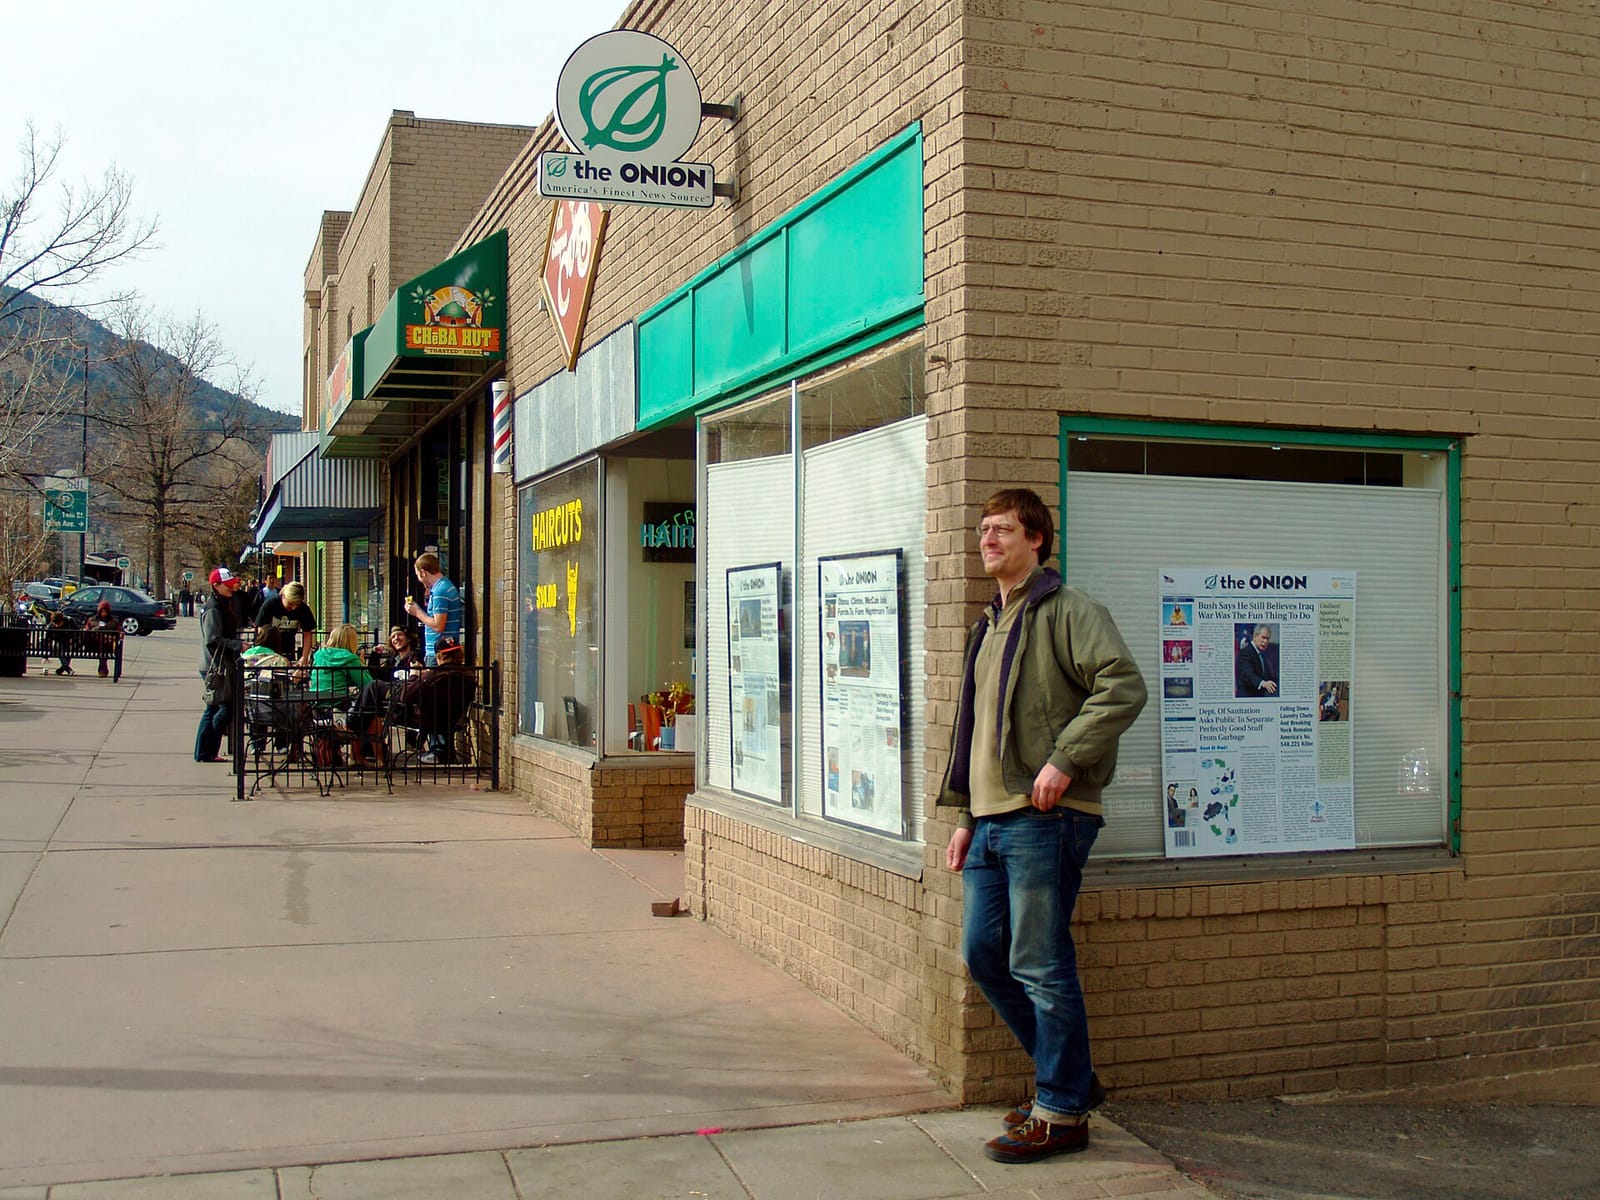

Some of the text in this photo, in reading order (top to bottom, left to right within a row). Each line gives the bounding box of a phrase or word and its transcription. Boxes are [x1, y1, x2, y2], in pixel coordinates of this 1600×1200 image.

[574, 160, 706, 190] the ONION
[545, 183, 598, 195] America's
[603, 187, 635, 197] Finest
[640, 190, 666, 200] News
[462, 329, 492, 347] HUT
[532, 497, 582, 552] HAIRCUTS
[640, 523, 695, 548] HAIR
[856, 570, 878, 585] ONION
[1220, 575, 1308, 590] the ONION
[1198, 601, 1315, 612] Bush Says He Still Believes Iraq
[1198, 611, 1311, 621] War Was The Fun Thing To Do
[1199, 708, 1216, 716] Dept.
[1246, 715, 1275, 724] Separate
[1200, 725, 1228, 733] Perfectly
[1218, 733, 1246, 742] Garbage
